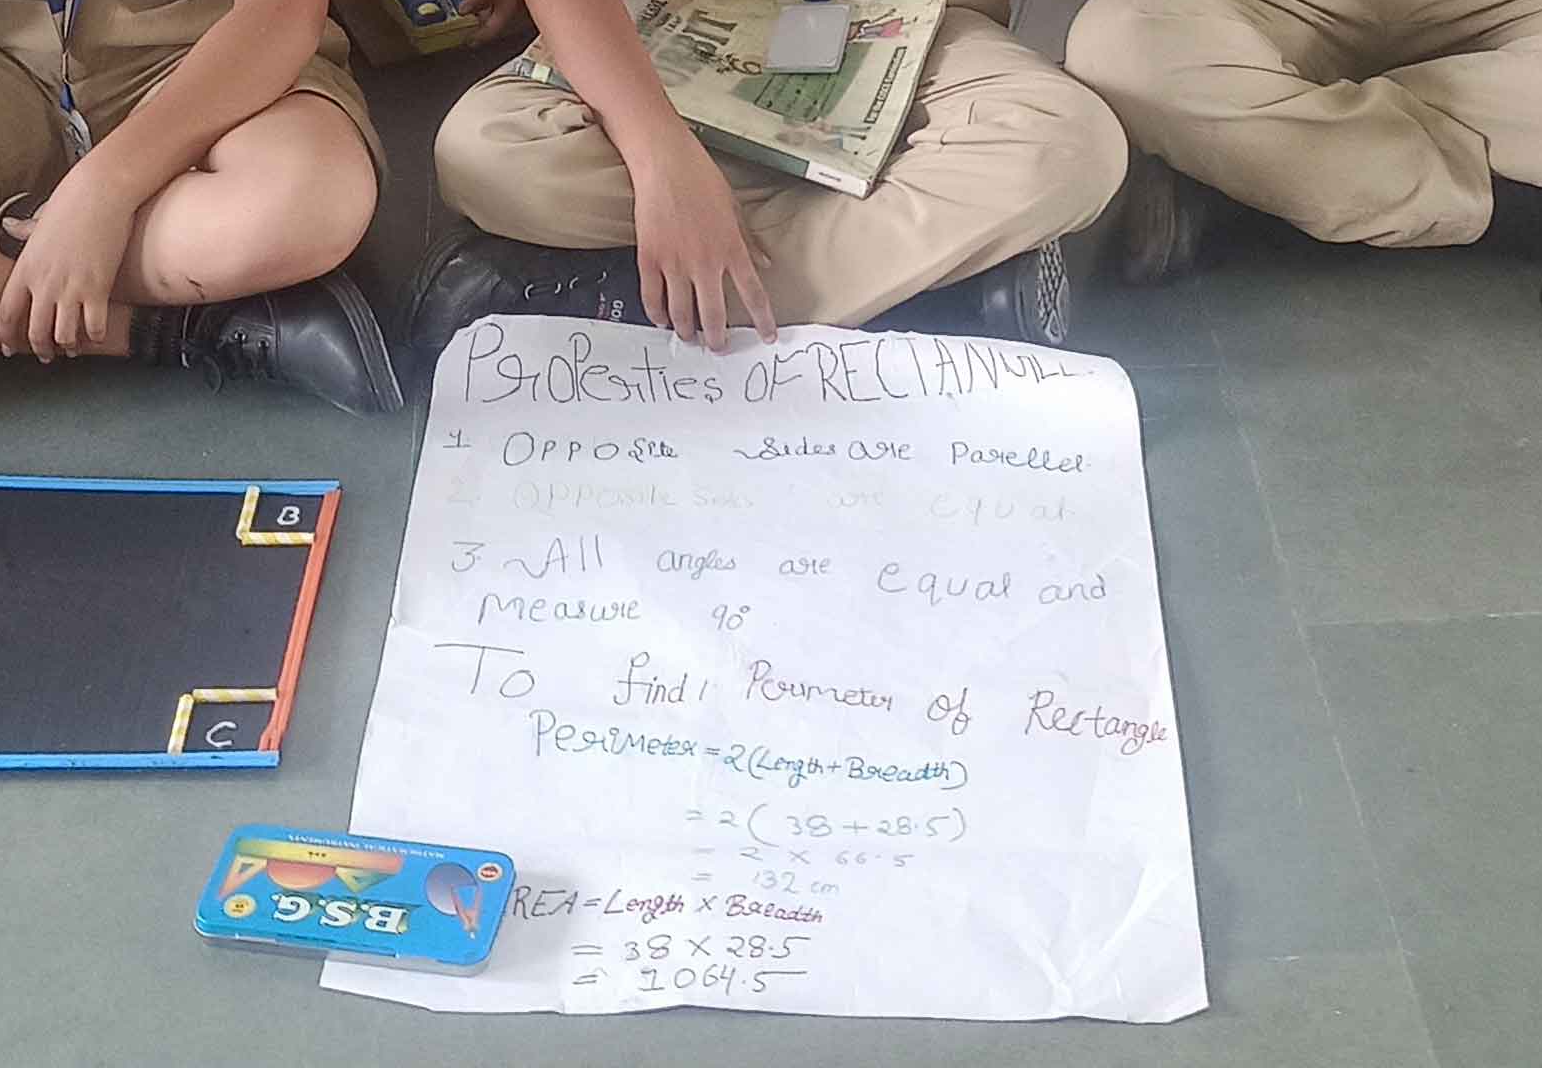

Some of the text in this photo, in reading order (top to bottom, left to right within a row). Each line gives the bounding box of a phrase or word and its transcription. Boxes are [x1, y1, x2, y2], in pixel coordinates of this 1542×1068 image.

[848, 440, 916, 461] are
[277, 505, 300, 526] B
[503, 534, 603, 579] All
[658, 549, 737, 580] angles
[779, 556, 830, 576] are
[1038, 574, 1107, 605] and
[205, 720, 236, 748] C
[1024, 689, 1168, 756] Rectangle
[809, 878, 841, 895] cm
[270, 893, 408, 935] B.S.G.
[512, 884, 579, 920] REA
[624, 934, 672, 962] 38
[725, 935, 812, 960] 28.5
